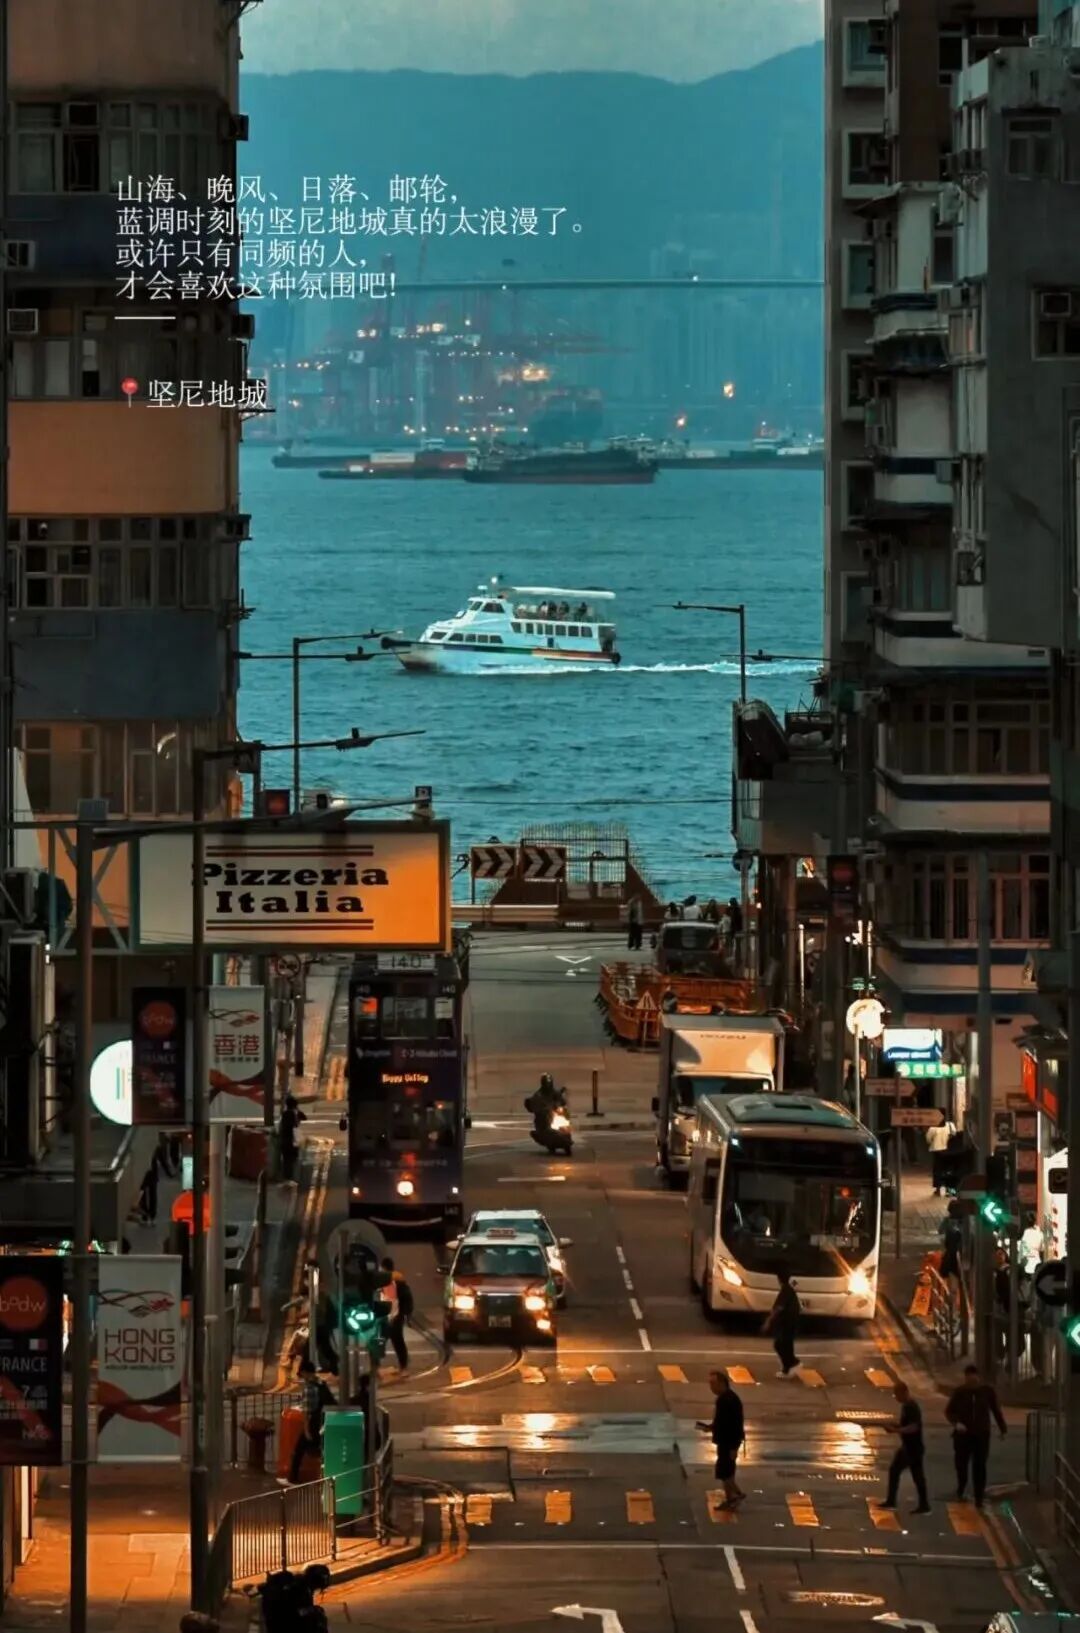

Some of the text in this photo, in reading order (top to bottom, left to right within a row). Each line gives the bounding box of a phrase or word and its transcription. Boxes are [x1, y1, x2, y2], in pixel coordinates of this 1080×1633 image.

[192, 863, 388, 886] Pizzeria
[216, 891, 363, 913] Italia
[214, 1034, 259, 1055] 香港
[105, 1328, 175, 1345] HONG
[105, 1346, 175, 1363] KONG
[0, 1357, 48, 1373] RANCE
